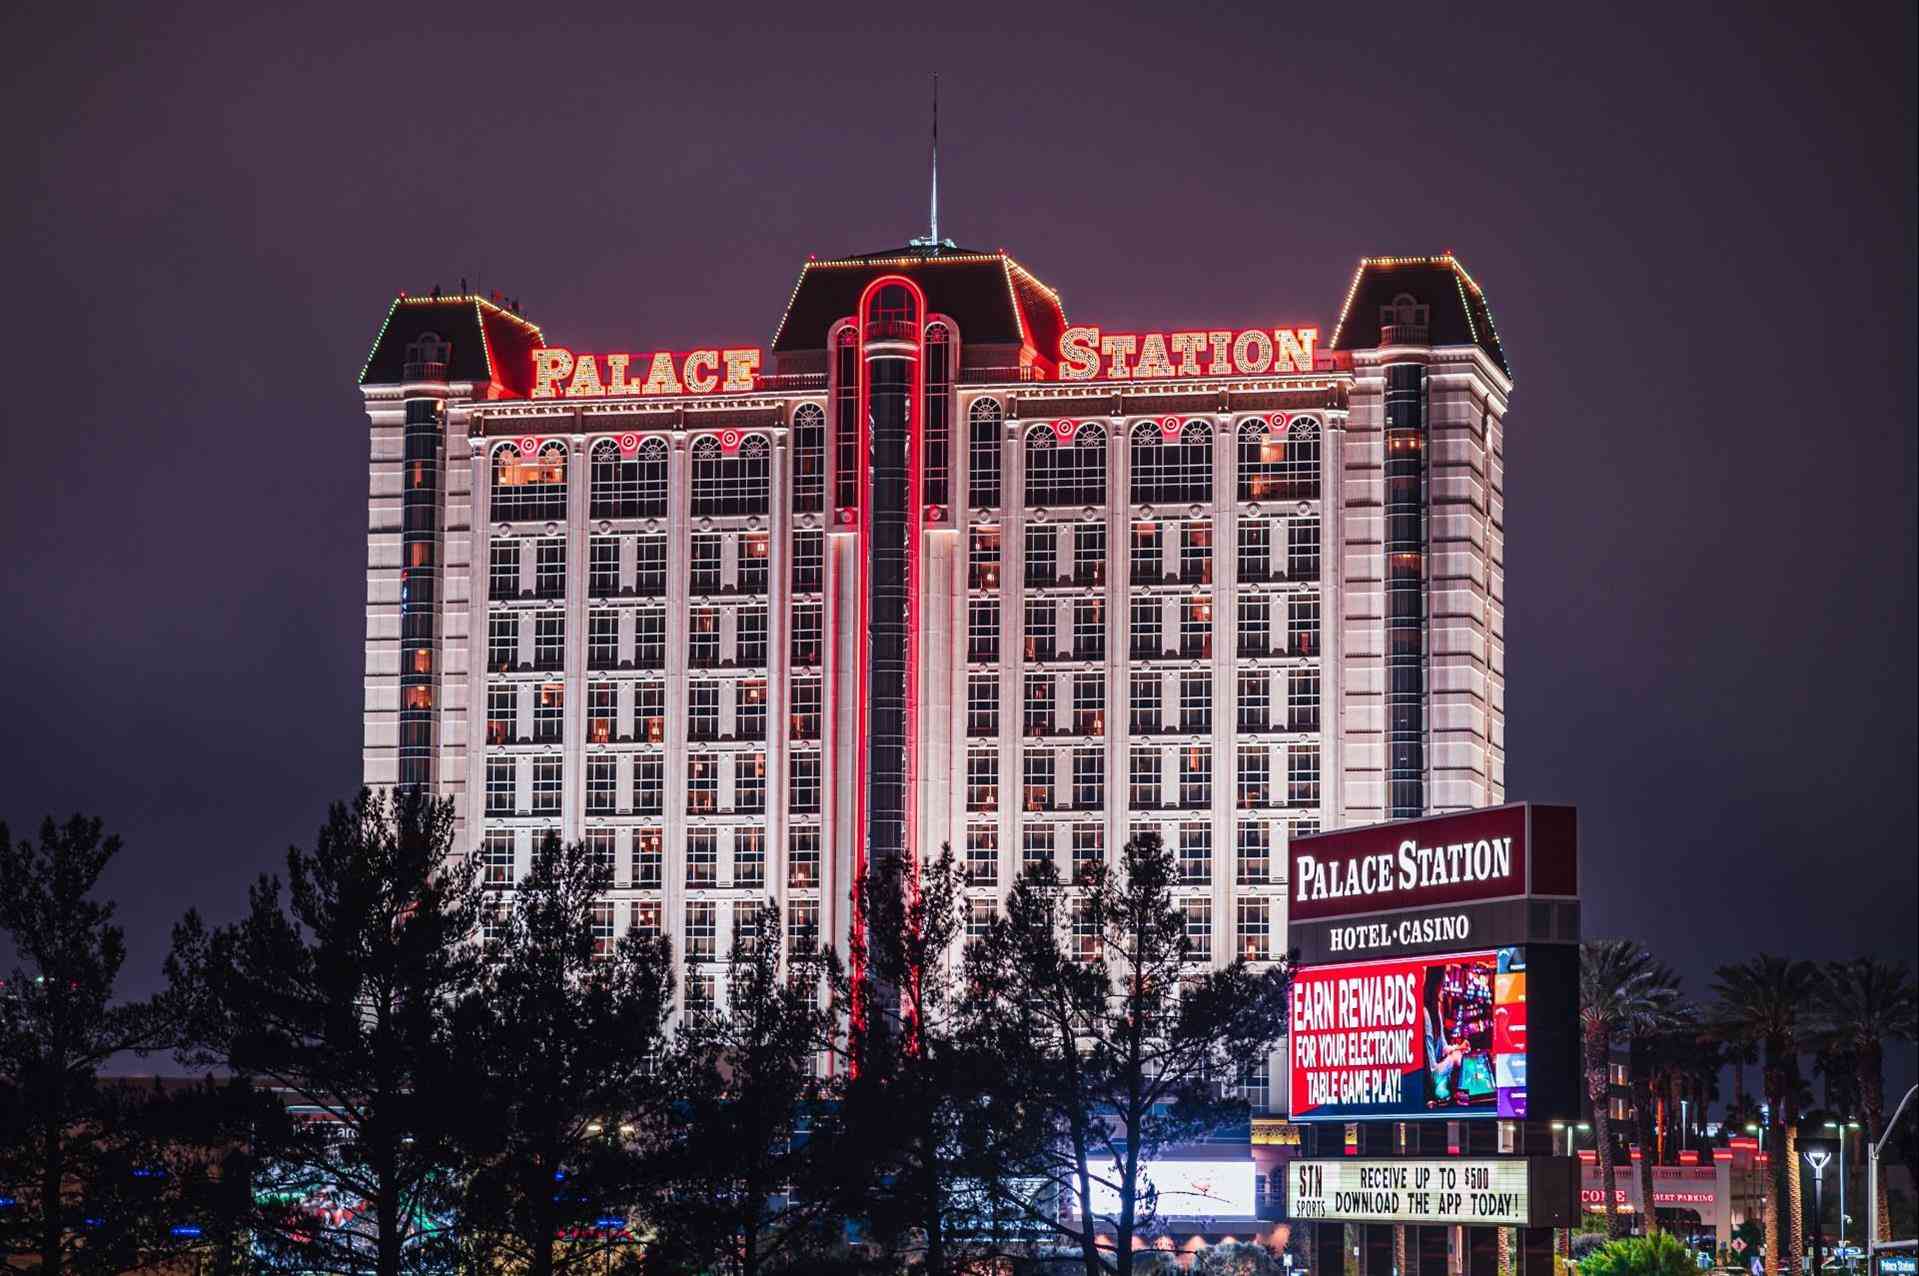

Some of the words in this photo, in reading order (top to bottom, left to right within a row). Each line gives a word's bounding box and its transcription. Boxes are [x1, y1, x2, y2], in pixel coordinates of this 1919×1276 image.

[531, 348, 761, 399] PALACE
[1058, 327, 1318, 380] STATION
[1296, 854, 1394, 902] PALACE
[1398, 837, 1512, 892] STATION
[1294, 980, 1335, 1032] EARN
[1338, 972, 1417, 1029] REWARDS
[1296, 1034, 1317, 1068] FOR
[1318, 1032, 1347, 1067] YOUR
[1348, 1028, 1414, 1066] ELECTRONIC
[1307, 1071, 1338, 1105] TABLE
[1340, 1069, 1371, 1105] GAME
[1372, 1068, 1402, 1104] PLAY!
[1299, 1165, 1323, 1198] STN
[1360, 1167, 1408, 1190] RECEIVE
[1415, 1167, 1431, 1190] UP
[1439, 1167, 1456, 1190] TO
[1464, 1167, 1490, 1190] $500
[1296, 1200, 1326, 1218] SPORTS
[1335, 1191, 1400, 1214] DOWNLOAD
[1408, 1192, 1430, 1215] THE
[1438, 1193, 1462, 1215] APP
[1470, 1193, 1519, 1218] TODAY!
